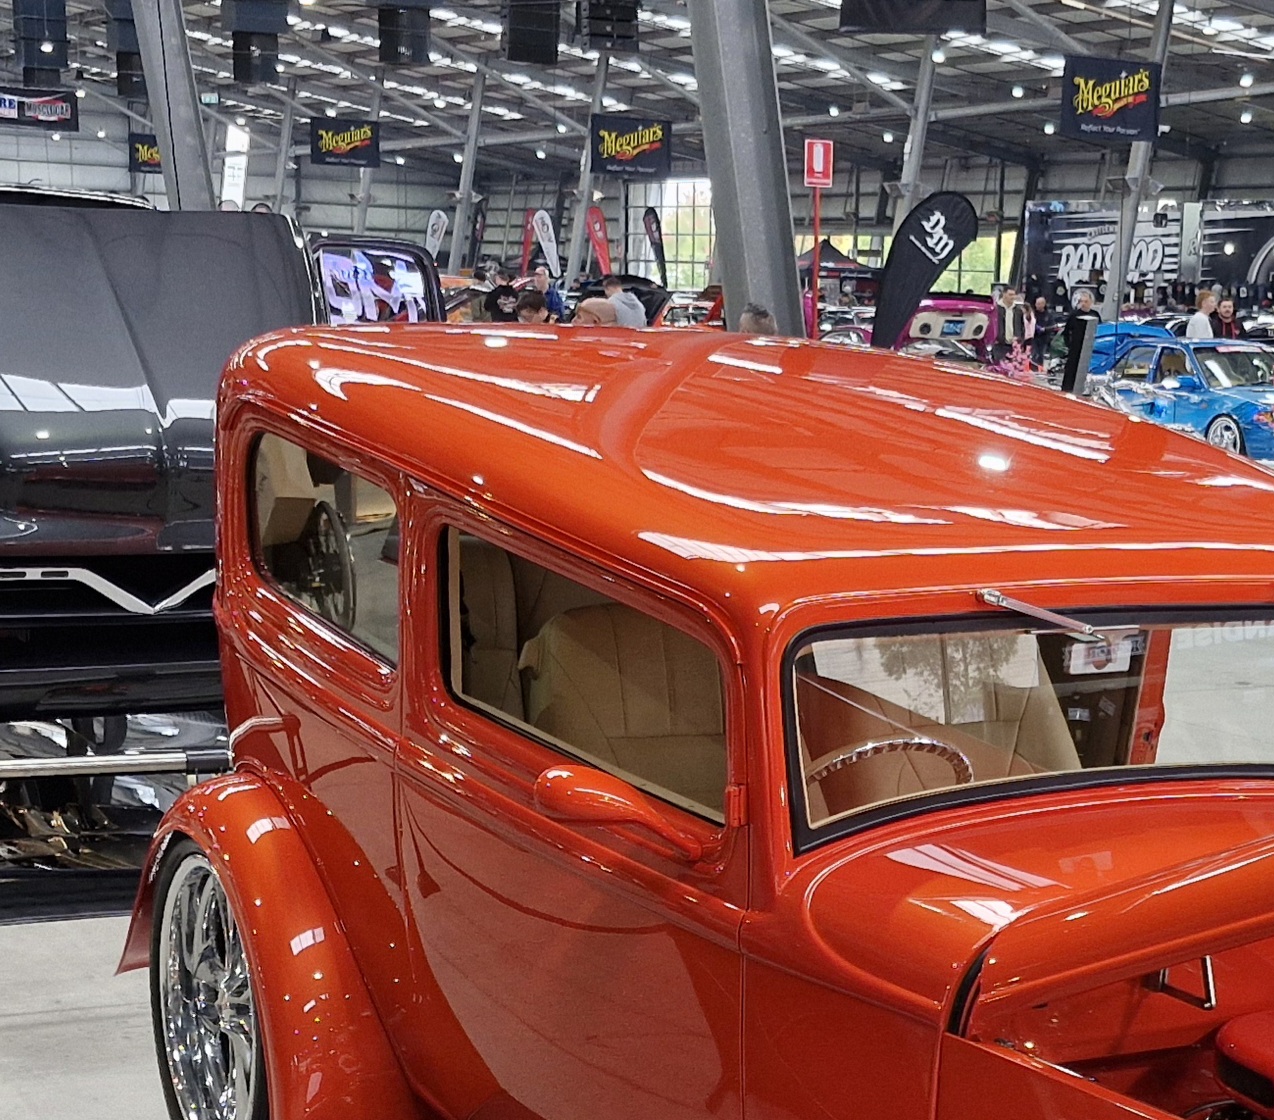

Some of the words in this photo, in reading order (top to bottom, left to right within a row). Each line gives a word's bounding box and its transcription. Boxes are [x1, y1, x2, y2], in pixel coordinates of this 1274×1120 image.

[1073, 69, 1151, 116] Meguiar's
[318, 125, 373, 153] Meguiar's
[598, 123, 664, 158] Meguiar's
